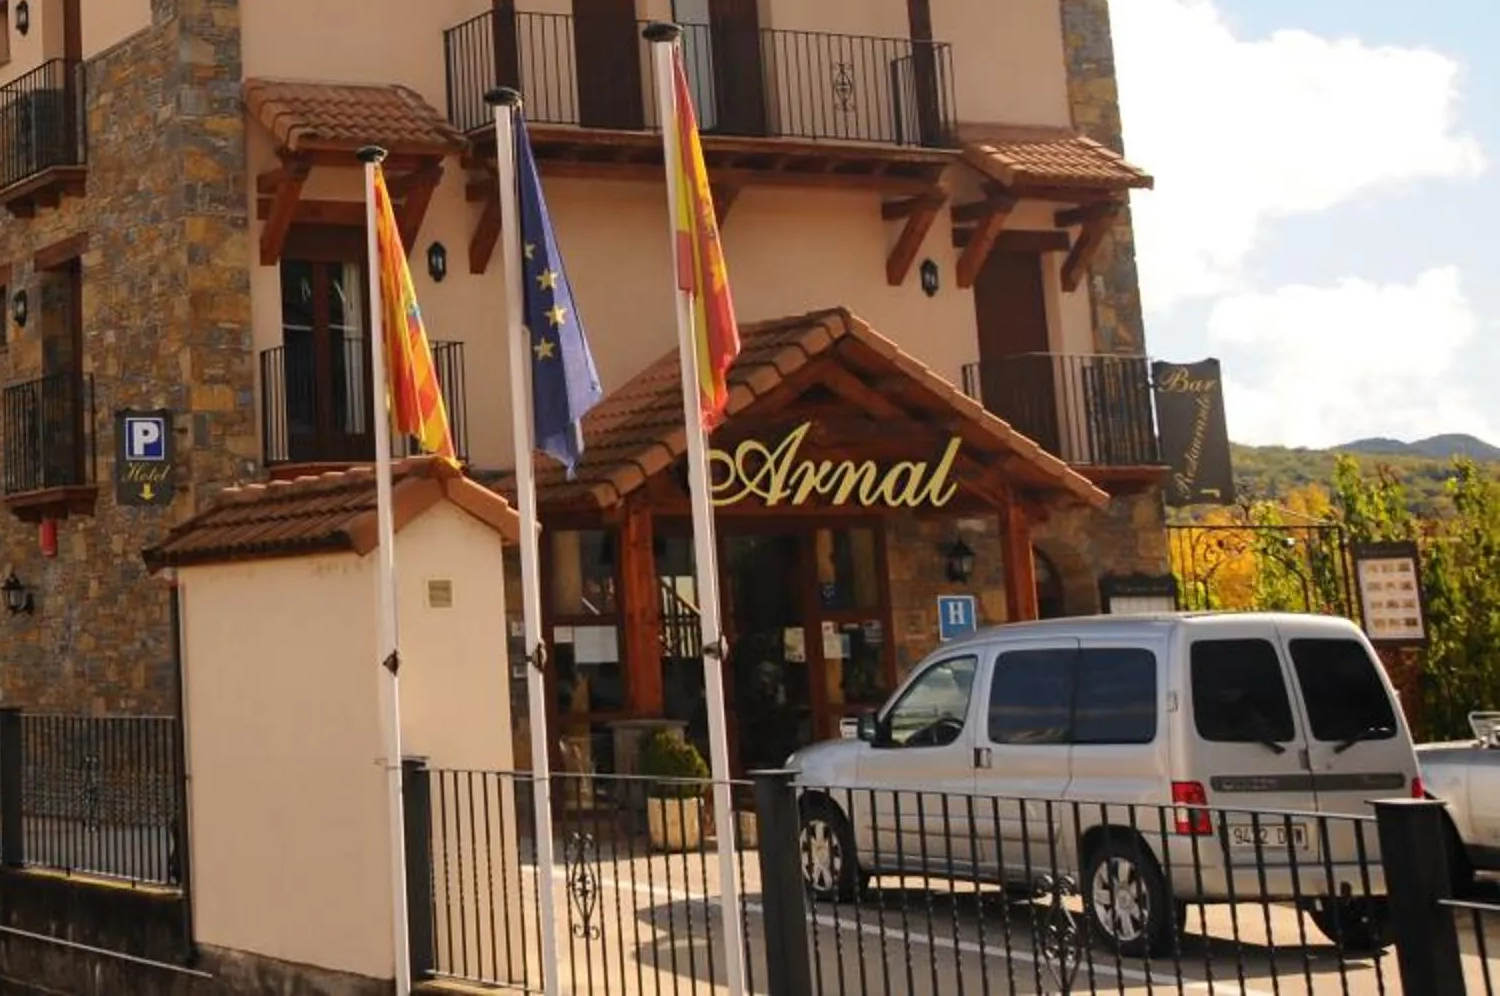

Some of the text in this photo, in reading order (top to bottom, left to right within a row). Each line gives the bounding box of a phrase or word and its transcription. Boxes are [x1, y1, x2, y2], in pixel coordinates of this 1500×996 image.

[1158, 366, 1218, 393] Bar
[132, 421, 159, 455] P
[123, 463, 172, 482] Hotel
[707, 422, 962, 507] Arnal
[948, 601, 965, 625] H
[1233, 827, 1269, 845] 942
